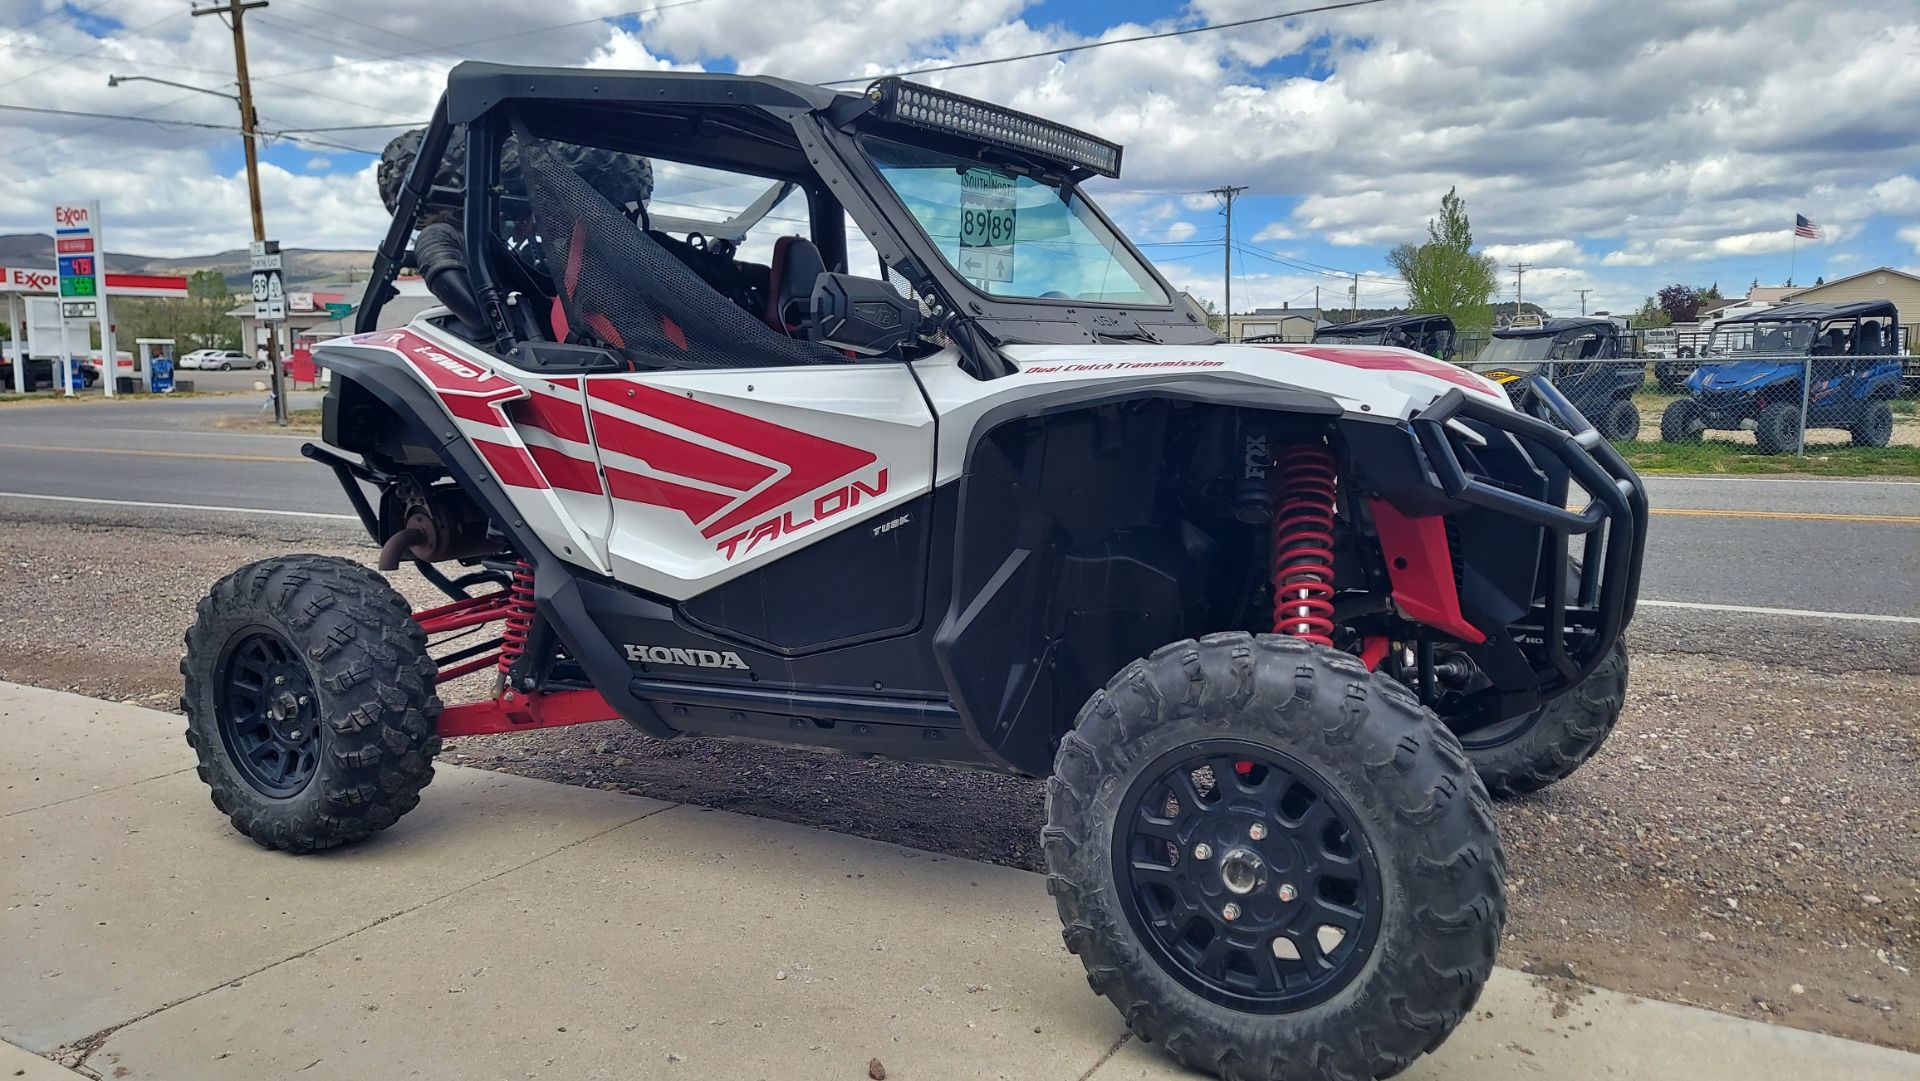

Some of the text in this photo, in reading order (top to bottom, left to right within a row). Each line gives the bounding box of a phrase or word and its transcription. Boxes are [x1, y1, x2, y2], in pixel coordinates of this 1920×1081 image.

[964, 172, 988, 191] SOUTH
[56, 207, 88, 226] Exxon
[964, 210, 1013, 240] 89 89
[254, 279, 266, 294] 89
[1025, 359, 1225, 375] Dual Clutch Transmission
[1245, 434, 1269, 479] FOX
[716, 467, 888, 562] TALON
[872, 513, 911, 536] TUSK
[623, 644, 750, 670] HONDA
